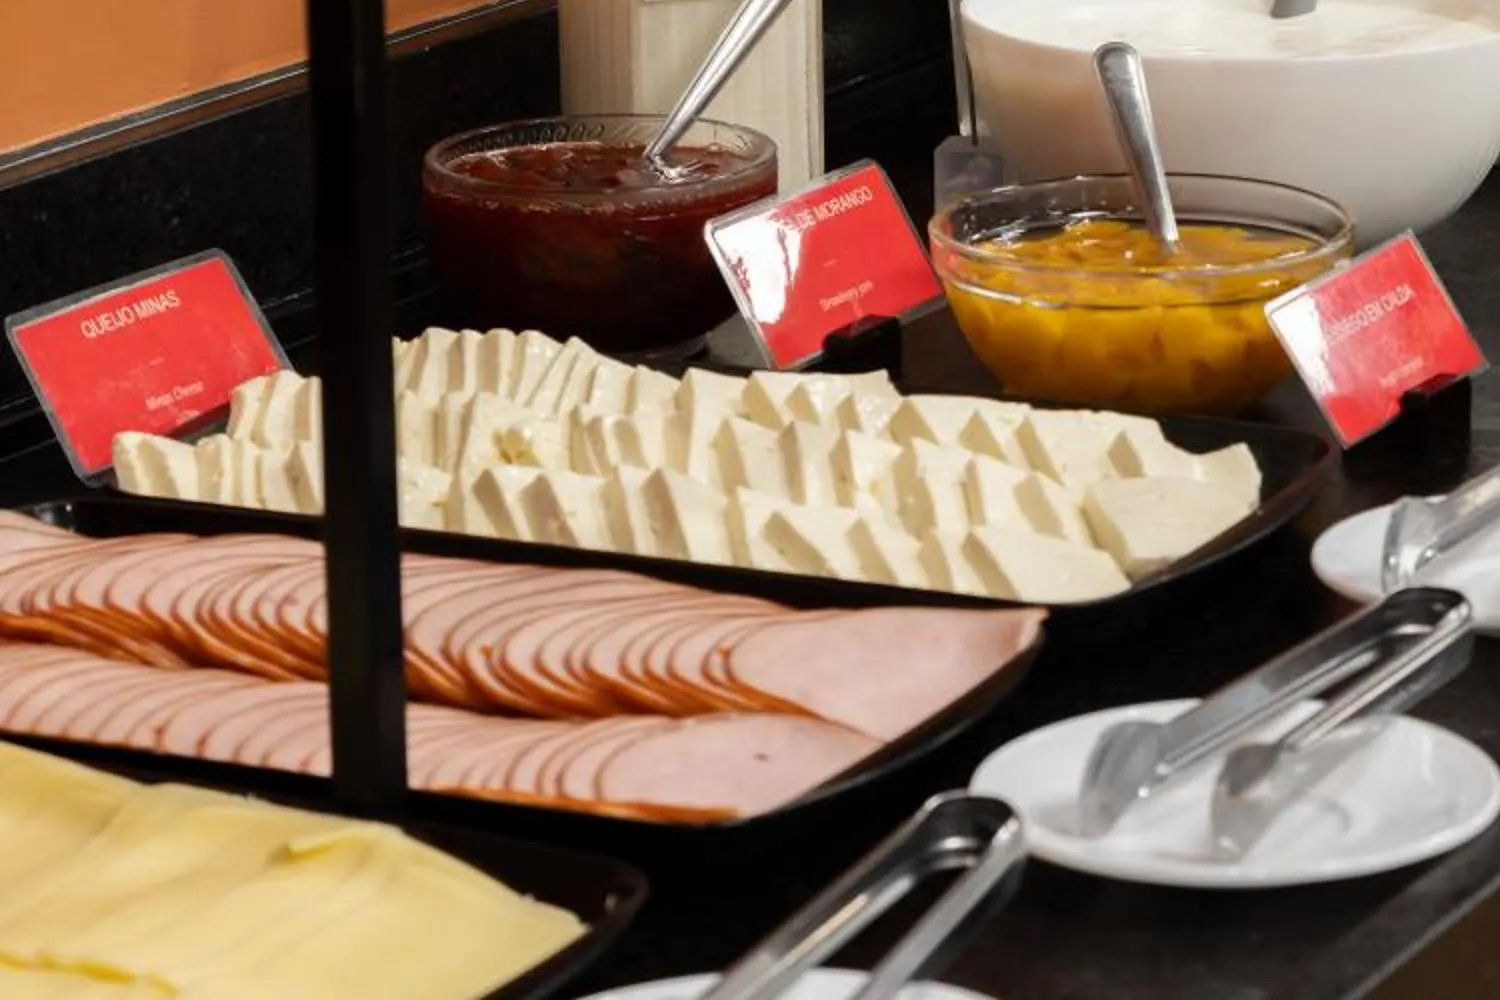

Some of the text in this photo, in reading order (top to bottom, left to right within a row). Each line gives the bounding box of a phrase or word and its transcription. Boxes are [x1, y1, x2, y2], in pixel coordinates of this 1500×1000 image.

[814, 187, 873, 221] MORANGO
[80, 290, 181, 338] QUEIJO MINAS
